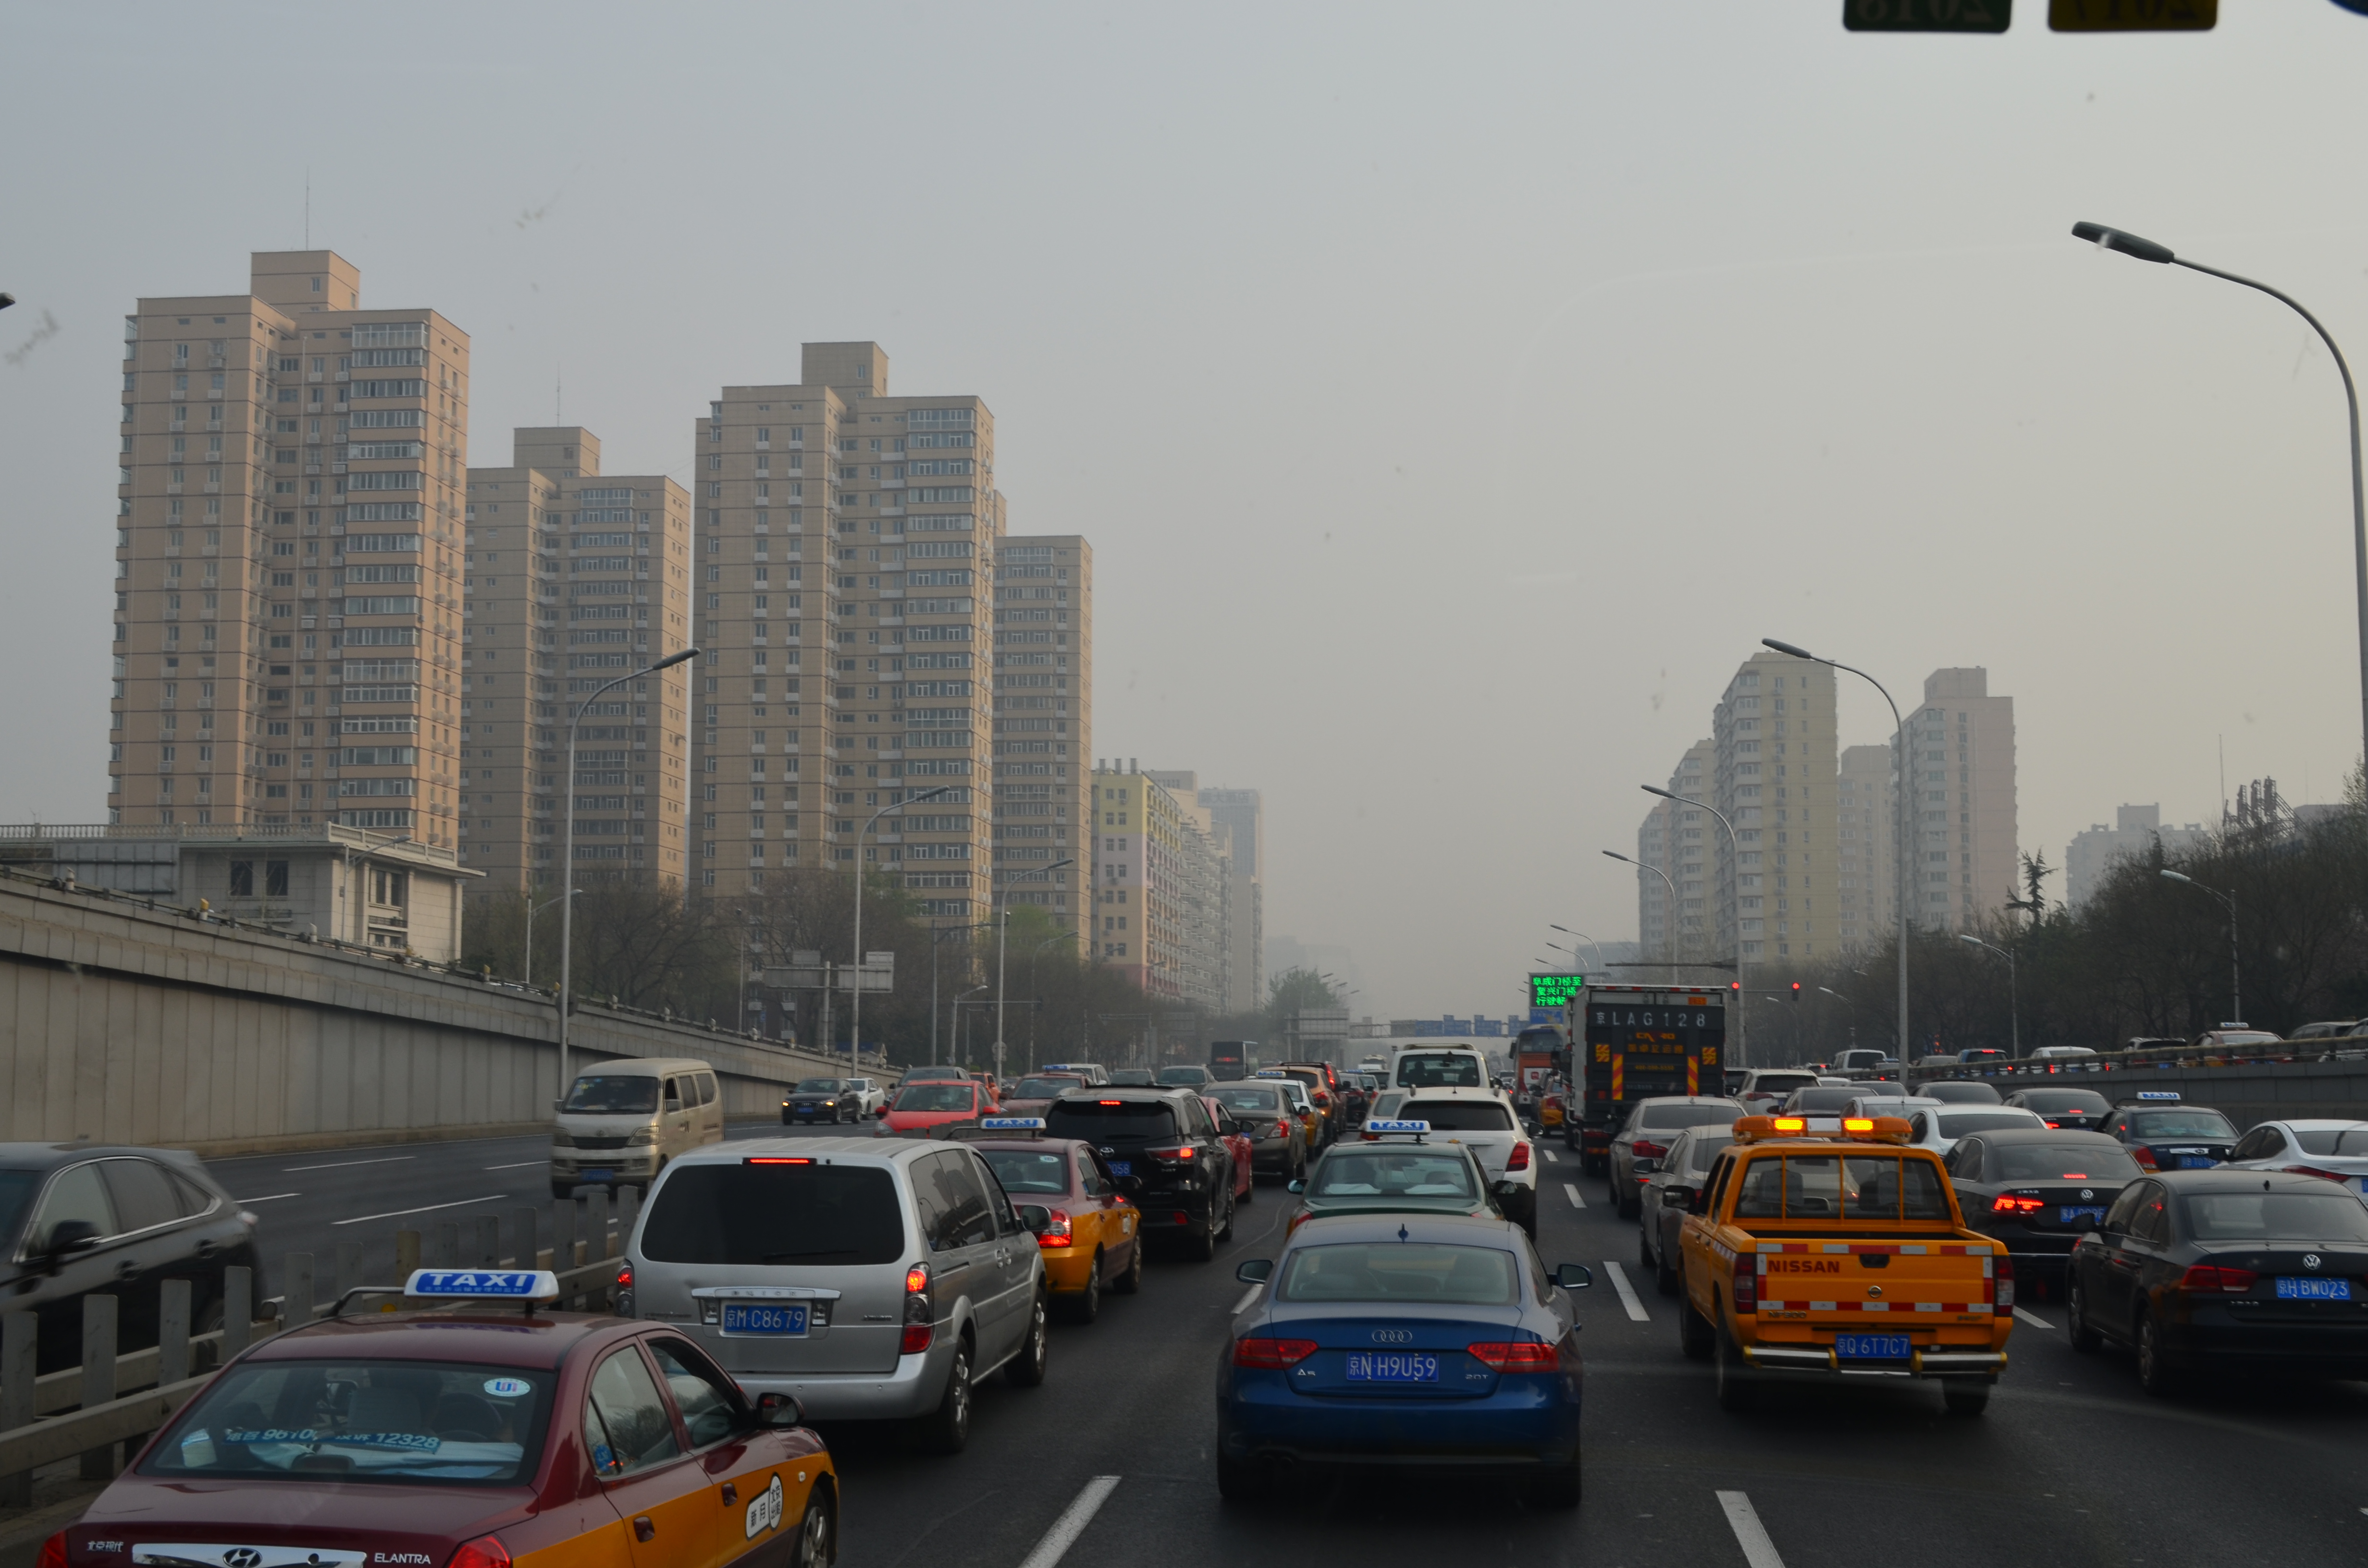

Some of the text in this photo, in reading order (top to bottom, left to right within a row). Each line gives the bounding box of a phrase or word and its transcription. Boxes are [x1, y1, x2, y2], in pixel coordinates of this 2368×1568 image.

[1533, 976, 1582, 986] 阜成门桥至
[1537, 986, 1577, 996] 复兴门桥
[1768, 1260, 1840, 1273] NISSAN
[430, 1274, 528, 1286] TAXI
[1297, 1368, 1316, 1376] A5
[376, 1433, 440, 1448] 12328
[374, 1552, 432, 1565] ELANTRA
